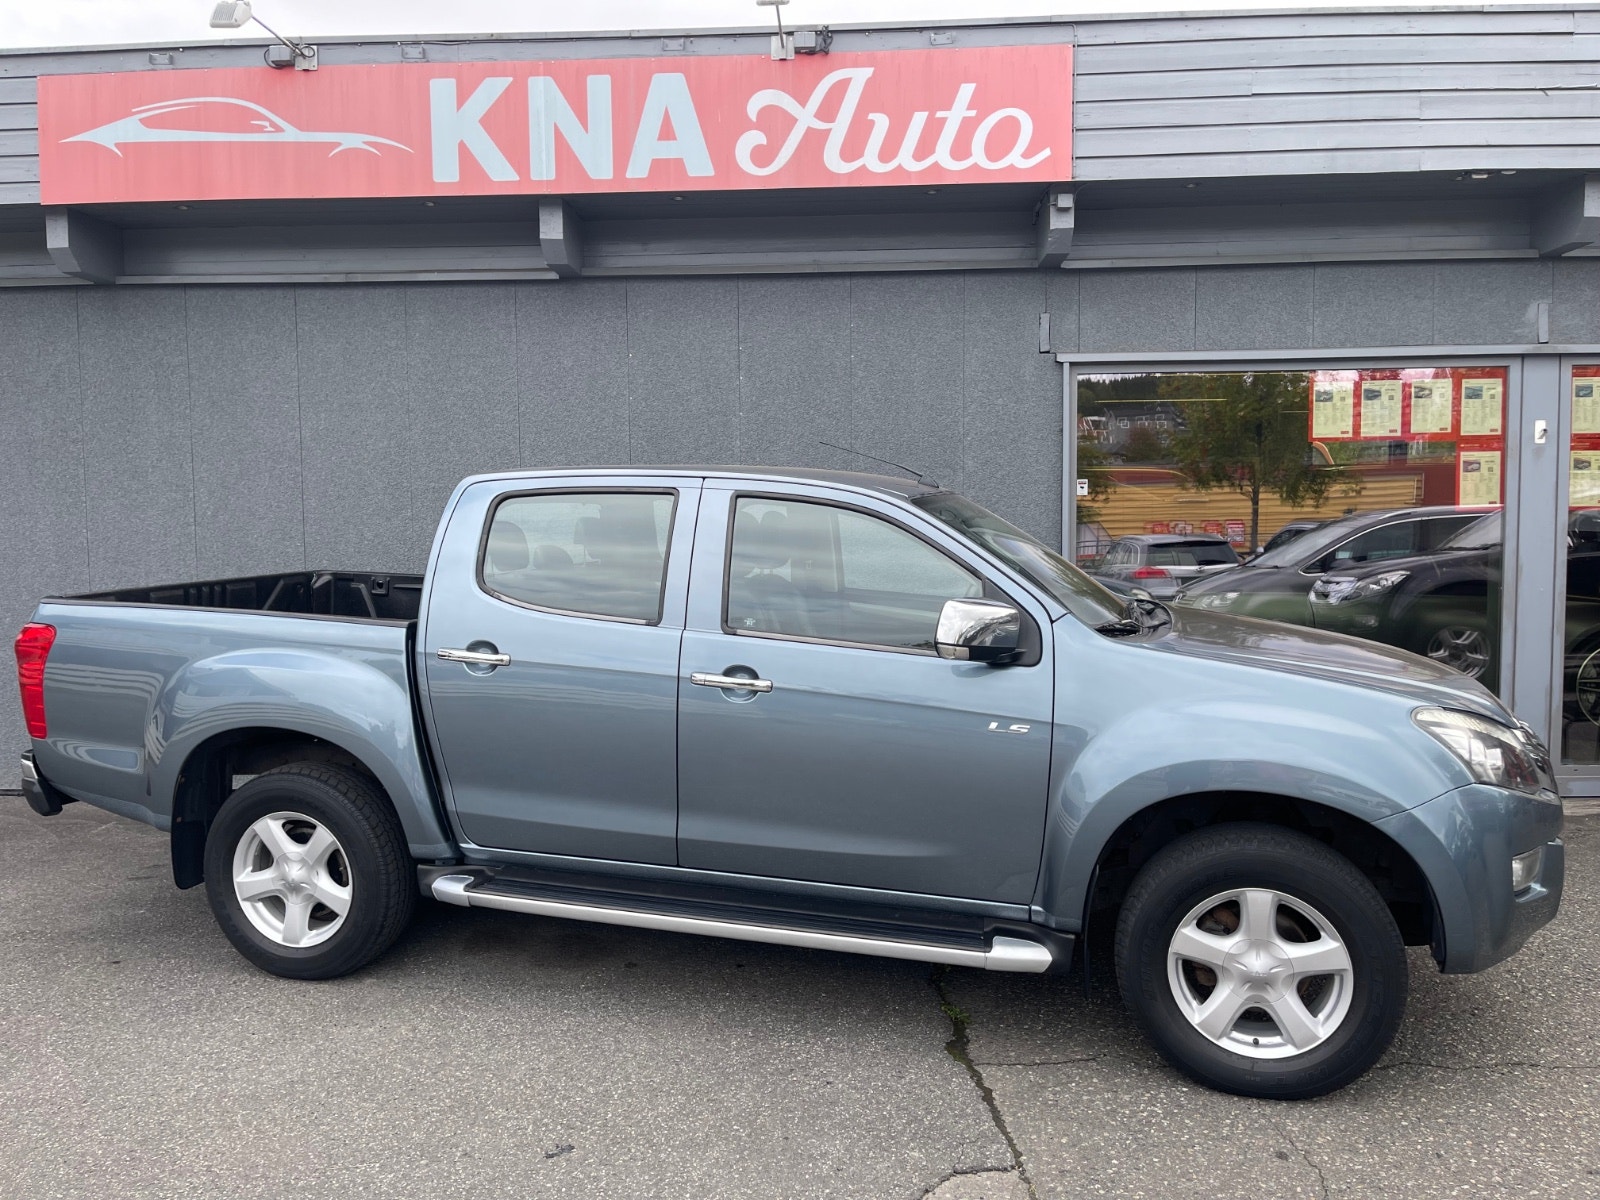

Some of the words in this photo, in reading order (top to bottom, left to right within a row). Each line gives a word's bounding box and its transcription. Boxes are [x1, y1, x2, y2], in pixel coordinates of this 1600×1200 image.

[429, 72, 715, 182] KNA
[735, 66, 1051, 177] Auto
[988, 721, 1031, 734] LS
